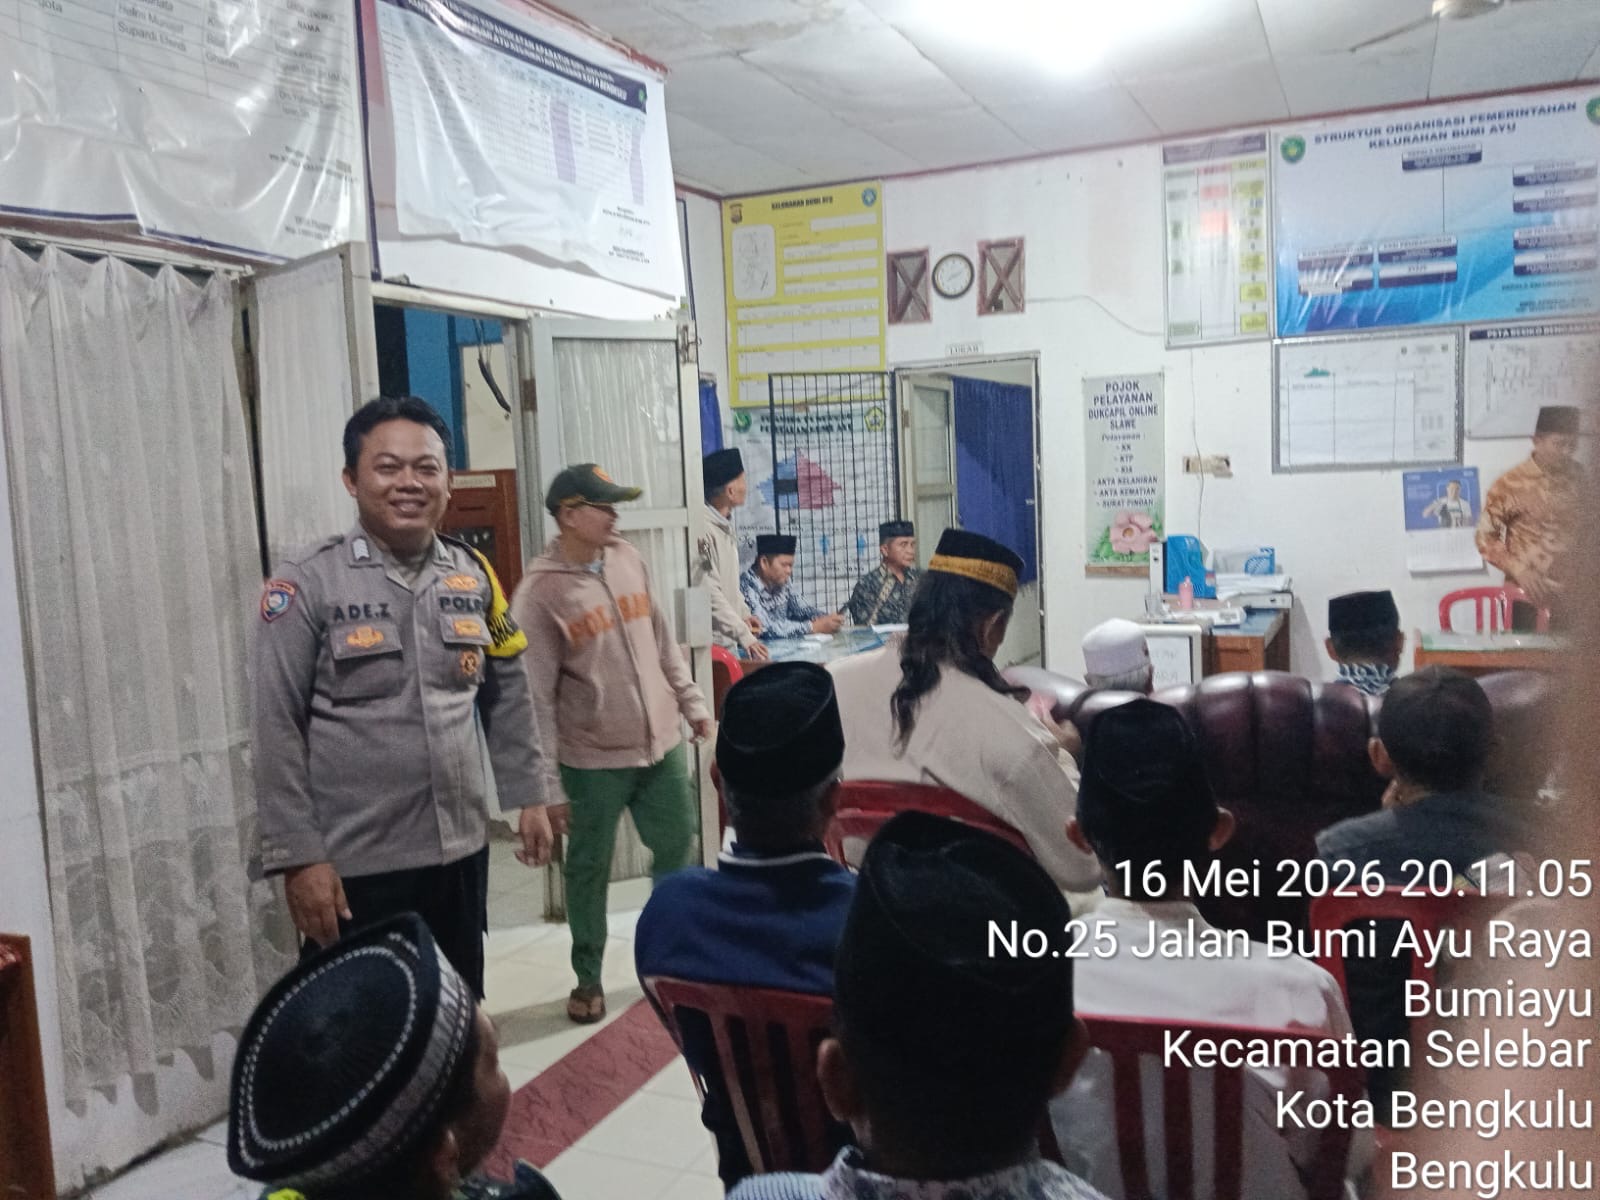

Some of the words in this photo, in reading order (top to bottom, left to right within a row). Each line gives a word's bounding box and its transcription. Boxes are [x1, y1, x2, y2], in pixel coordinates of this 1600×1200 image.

[1314, 126, 1382, 144] STRUKTUR
[1385, 115, 1466, 135] ORGANISASI
[1469, 101, 1577, 123] PEMERINTAHAN
[1369, 129, 1448, 149] KELURAHAN
[1452, 126, 1485, 138] BUMI
[1489, 122, 1516, 135] AYU
[1105, 381, 1140, 393] POJOK
[1093, 392, 1153, 406] PELAYANAN
[1088, 408, 1126, 420] DUKCAPIL
[1128, 405, 1159, 417] ONLINE
[1110, 419, 1136, 430] SLAWE
[1120, 454, 1133, 462] KTP
[1120, 487, 1155, 496] KEMATIAN
[333, 602, 391, 621] ADE.Z
